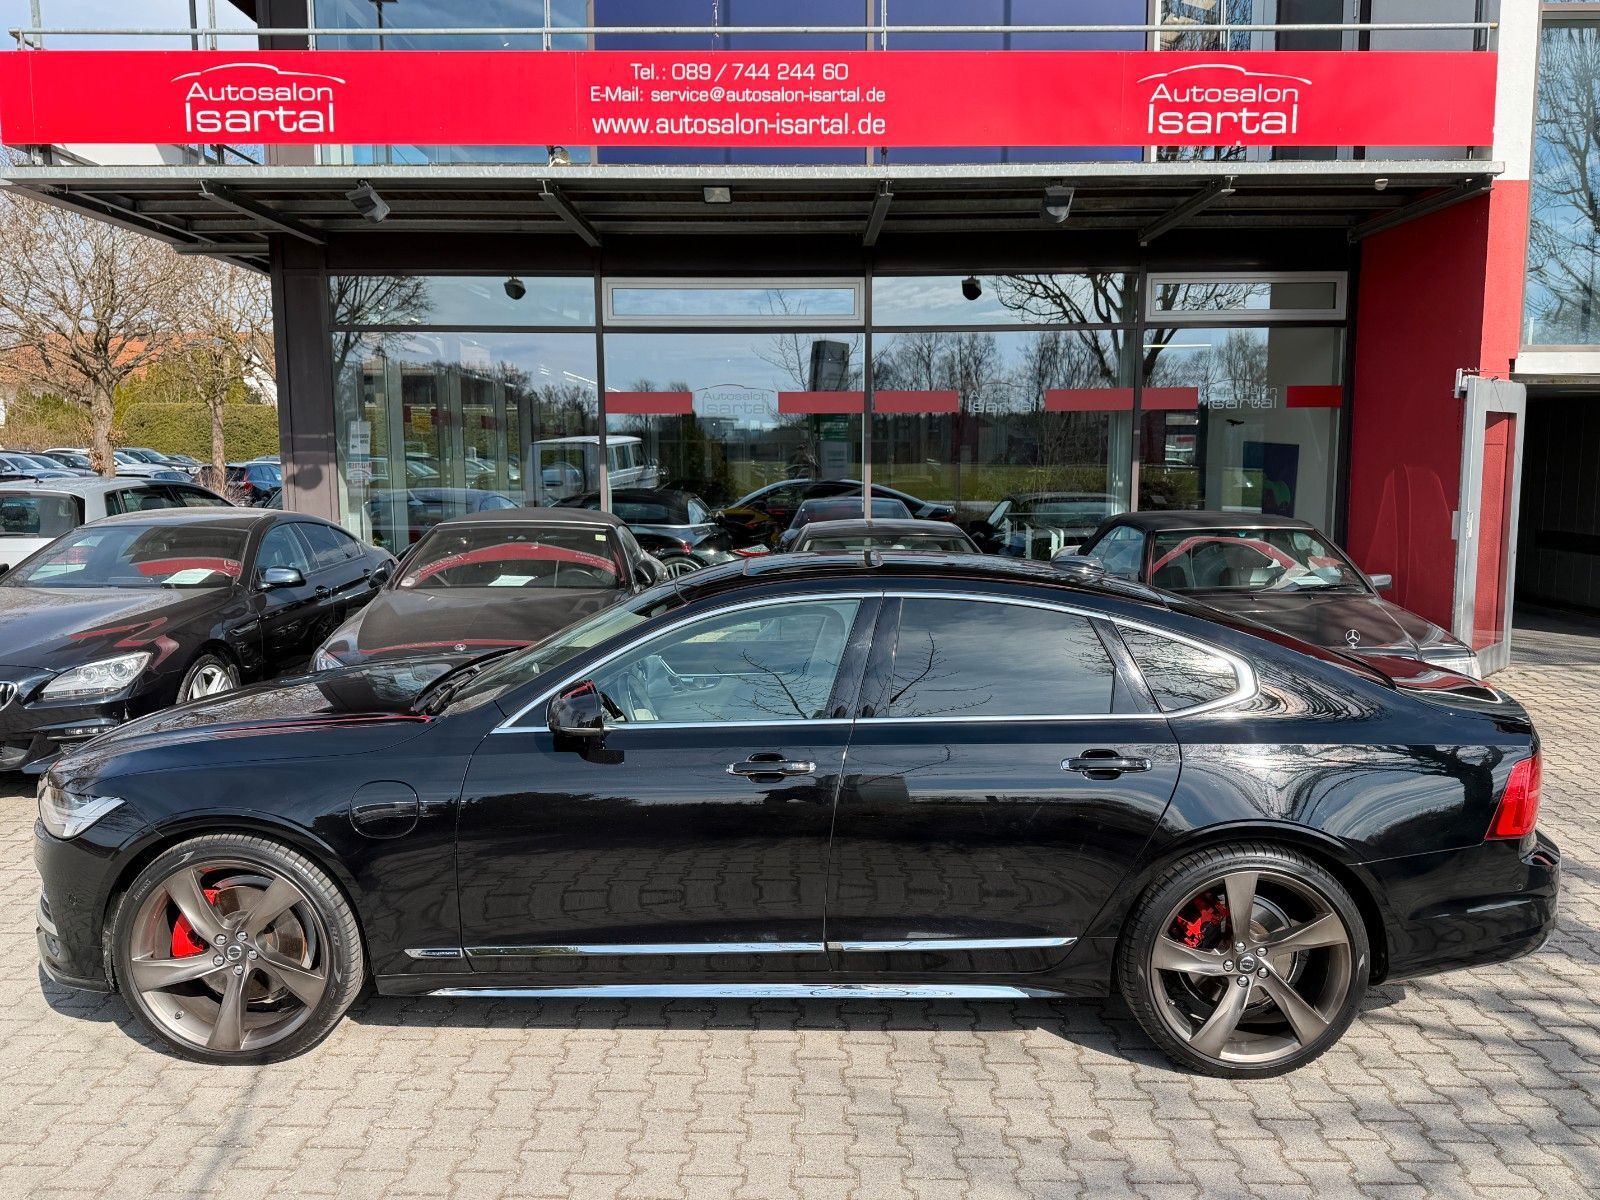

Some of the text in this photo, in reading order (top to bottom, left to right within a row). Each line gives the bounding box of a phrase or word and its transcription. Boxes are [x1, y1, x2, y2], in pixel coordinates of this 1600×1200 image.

[630, 62, 849, 83] Tel.: 089 / 744 244 60
[185, 82, 333, 102] Autosalon
[590, 86, 886, 103] E-Mail: service@autosalon-isartal.de
[1149, 83, 1299, 103] Autosalon
[185, 103, 335, 133] Isartal
[591, 113, 886, 135] www.autosalon-isartal.de
[1147, 103, 1299, 134] Isartal
[968, 398, 1037, 412] Isaral
